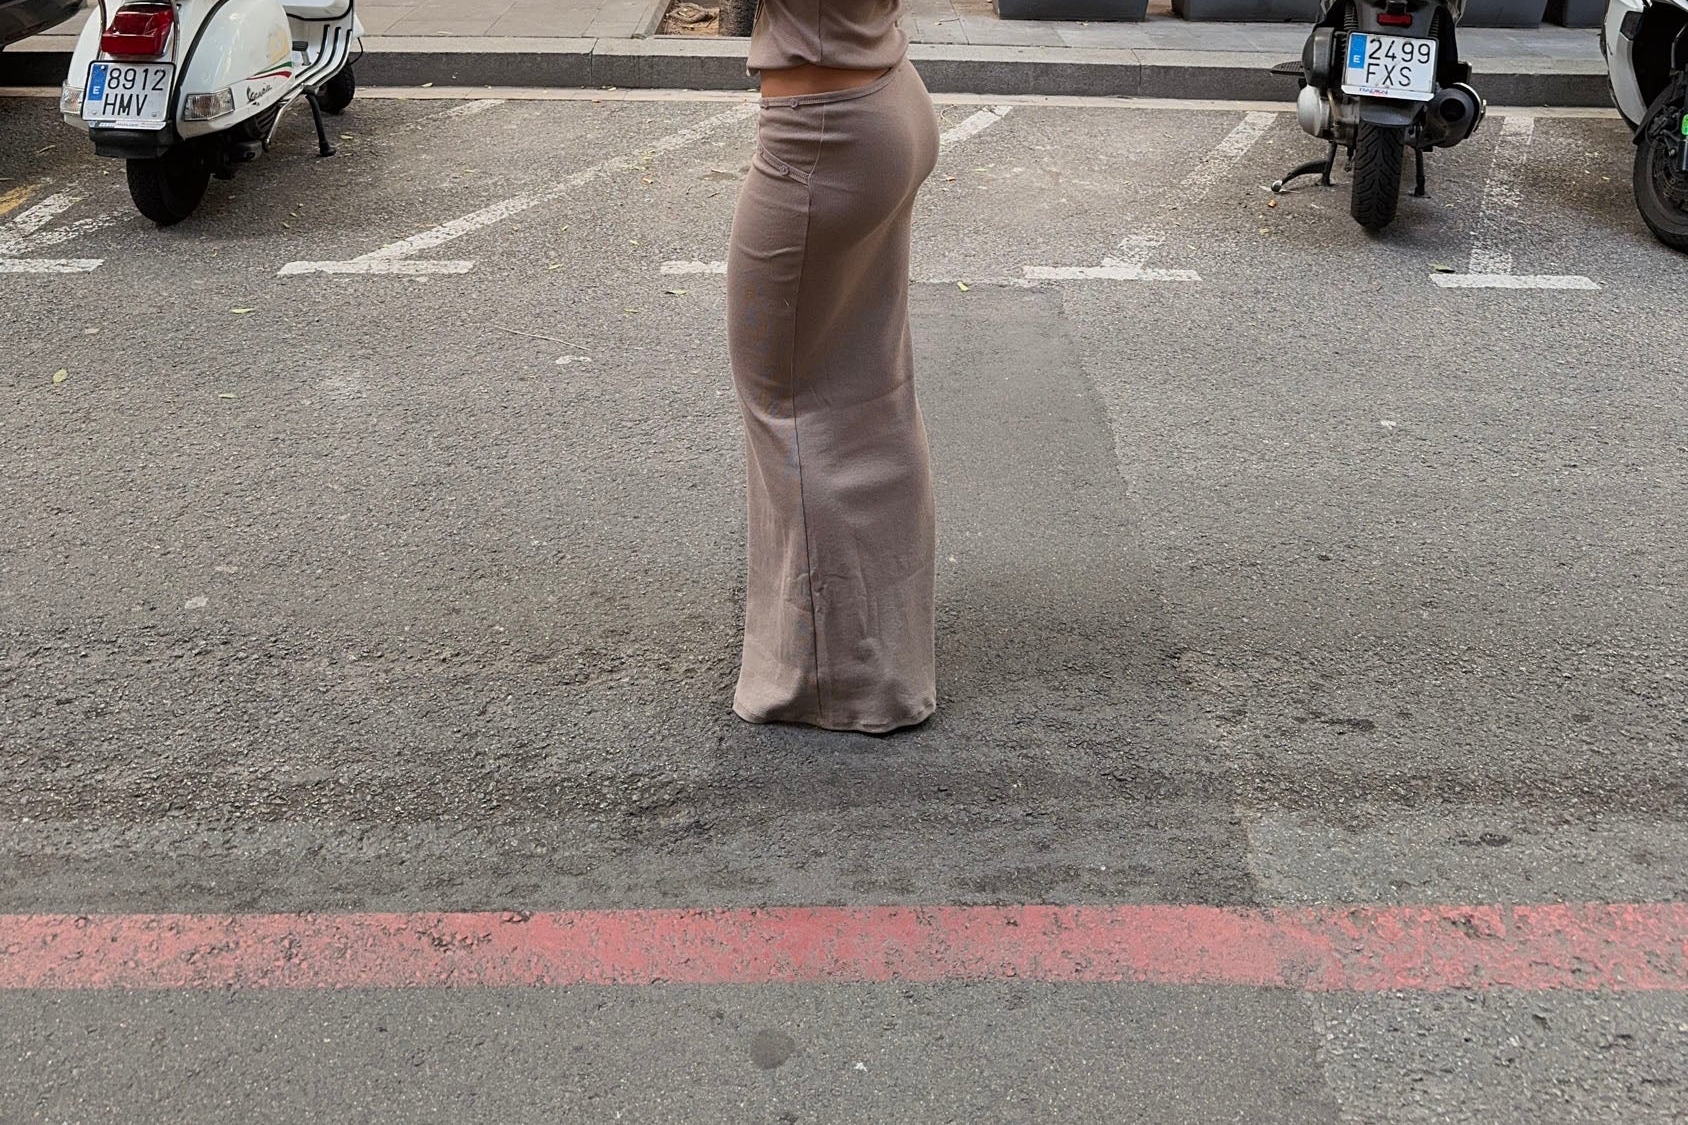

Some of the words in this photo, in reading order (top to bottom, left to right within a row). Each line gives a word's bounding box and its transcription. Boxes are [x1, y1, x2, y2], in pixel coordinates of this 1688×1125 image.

[1353, 55, 1361, 63] E
[1368, 38, 1431, 64] 2499
[107, 67, 166, 91] 8912
[1365, 62, 1412, 87] FXS
[92, 86, 100, 95] E
[102, 93, 148, 116] HMV
